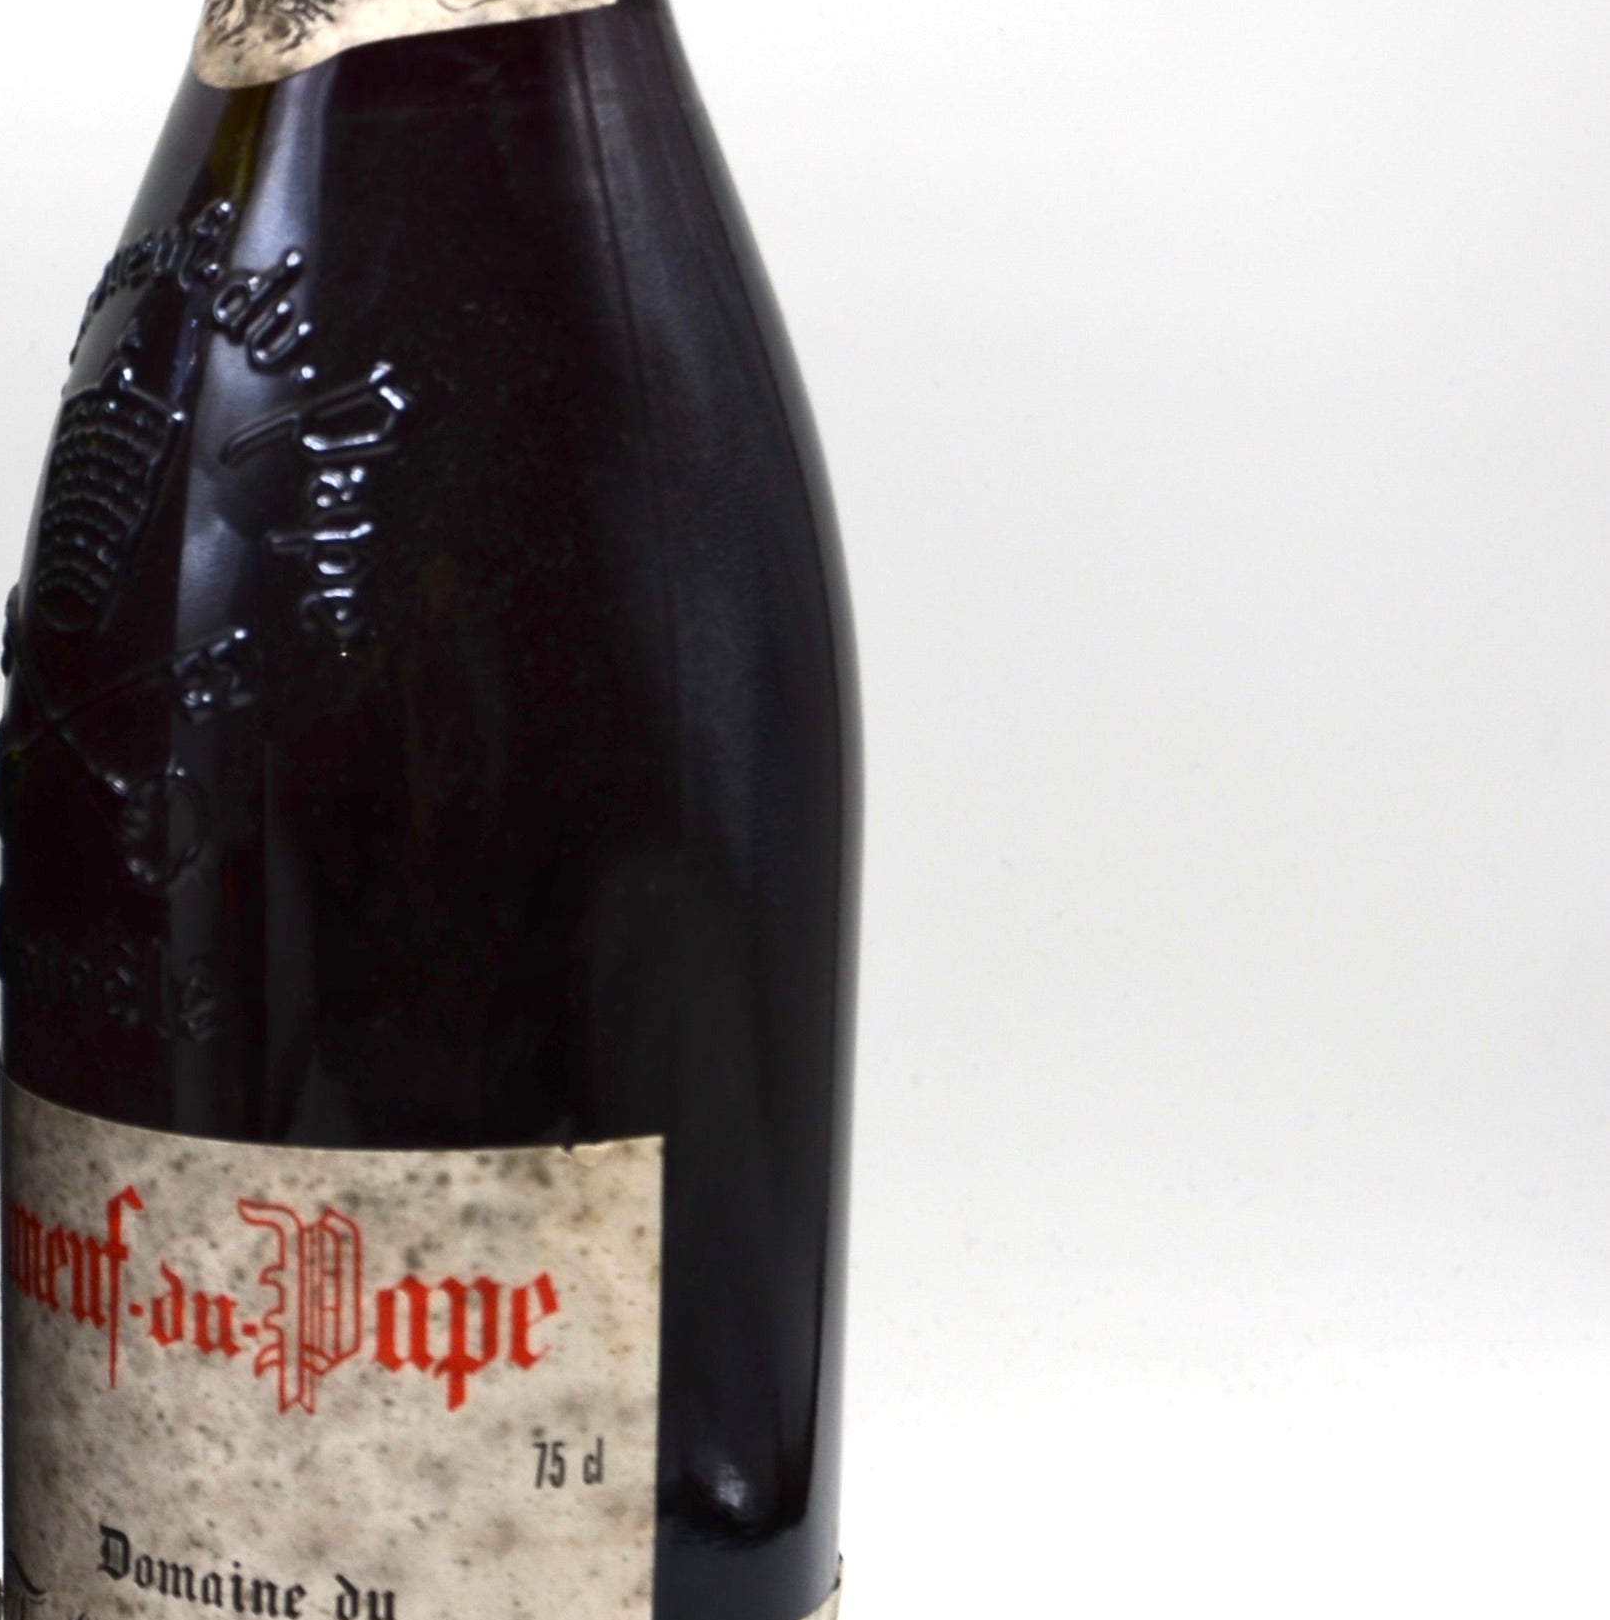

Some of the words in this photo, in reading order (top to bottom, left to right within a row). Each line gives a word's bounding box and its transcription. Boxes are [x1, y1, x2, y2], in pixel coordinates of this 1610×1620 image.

[534, 1440, 566, 1489] 75
[582, 1436, 605, 1486] cl
[97, 1524, 306, 1620] Domaine
